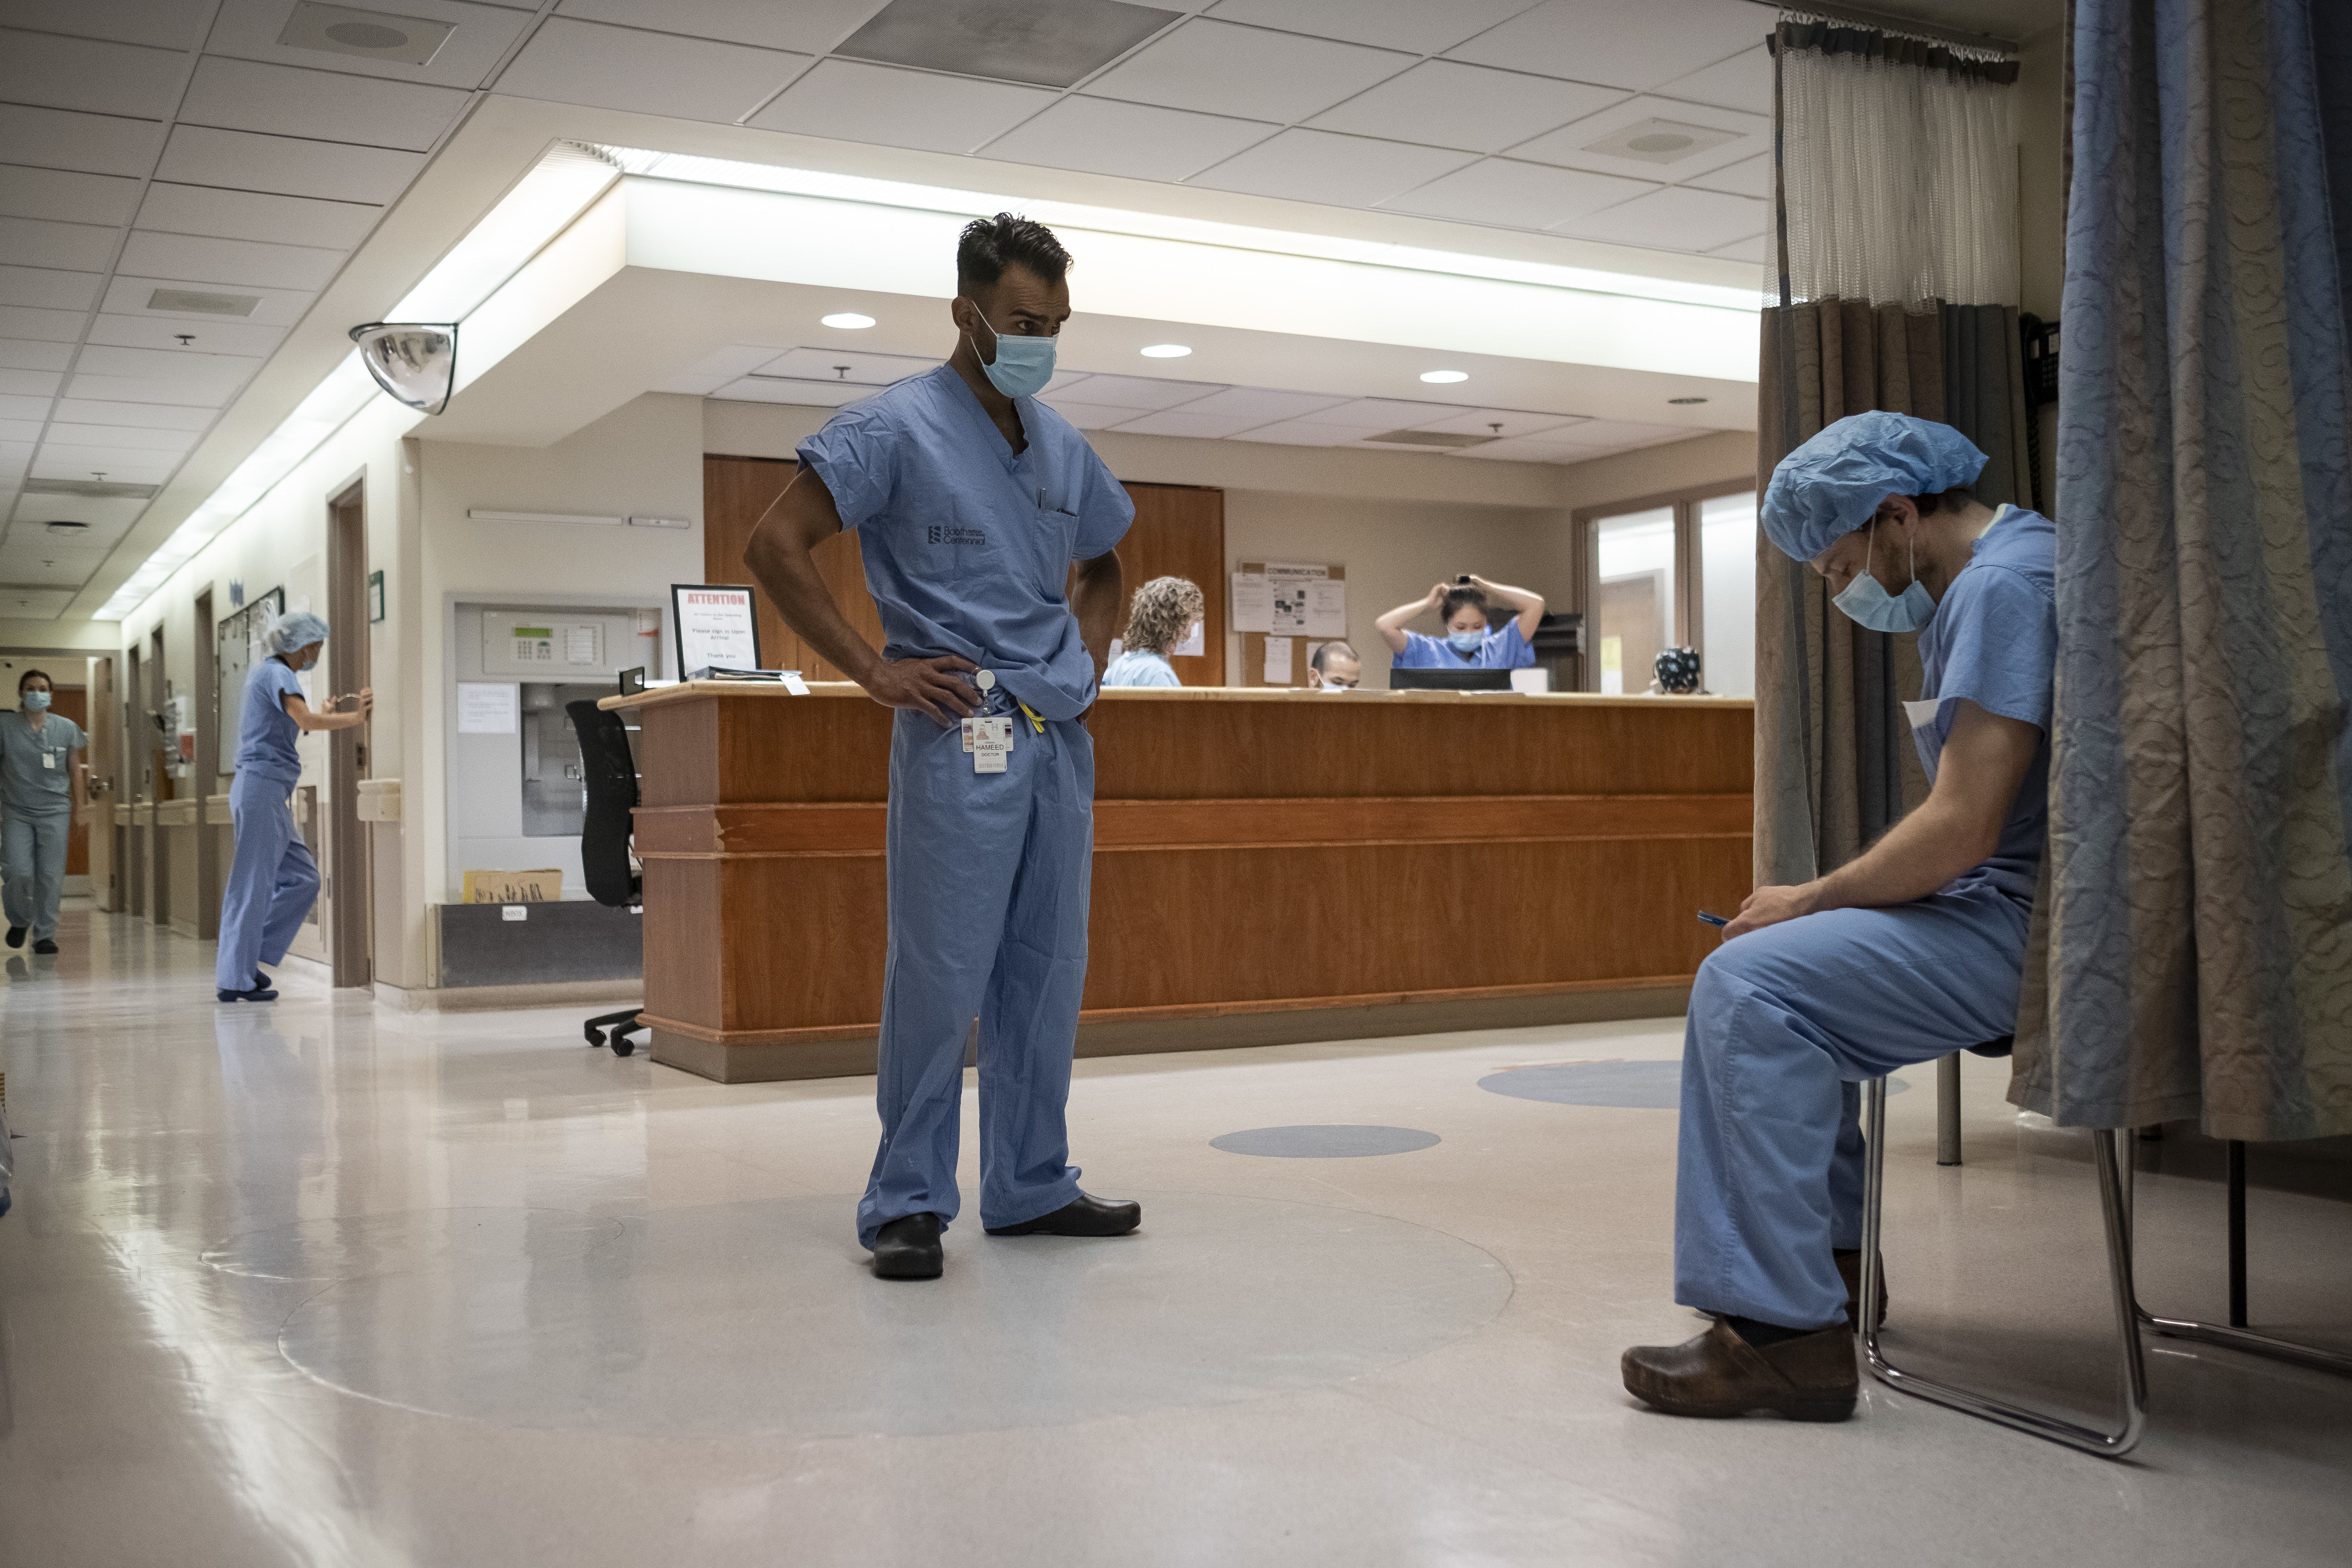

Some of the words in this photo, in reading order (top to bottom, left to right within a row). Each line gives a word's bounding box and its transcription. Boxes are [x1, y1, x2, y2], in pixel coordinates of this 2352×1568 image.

[944, 526, 968, 536] Booth
[944, 535, 985, 545] Centennial
[688, 593, 745, 605] ATTENTION
